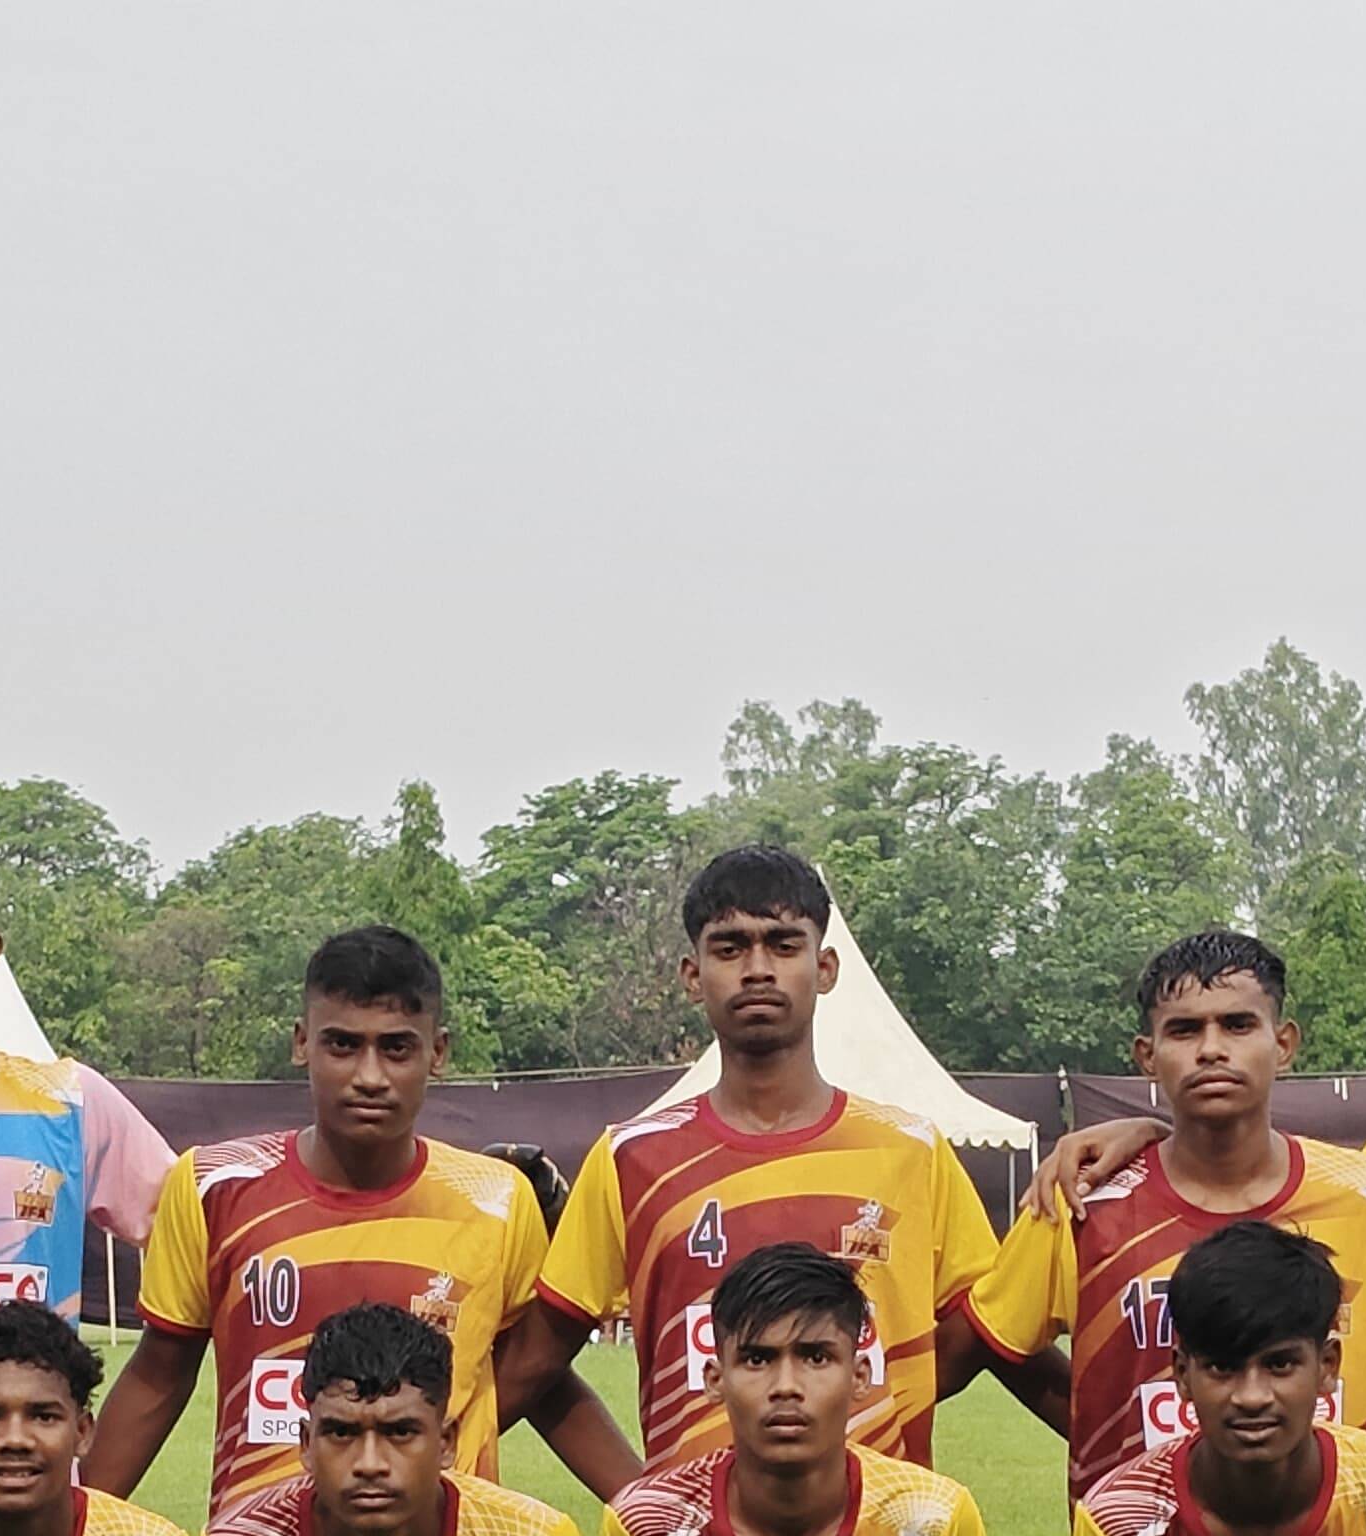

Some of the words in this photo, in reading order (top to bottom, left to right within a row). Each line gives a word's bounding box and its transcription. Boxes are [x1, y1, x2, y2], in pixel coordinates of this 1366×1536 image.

[688, 1199, 727, 1267] 4
[244, 1256, 299, 1326] 10
[262, 1419, 301, 1437] SPO
